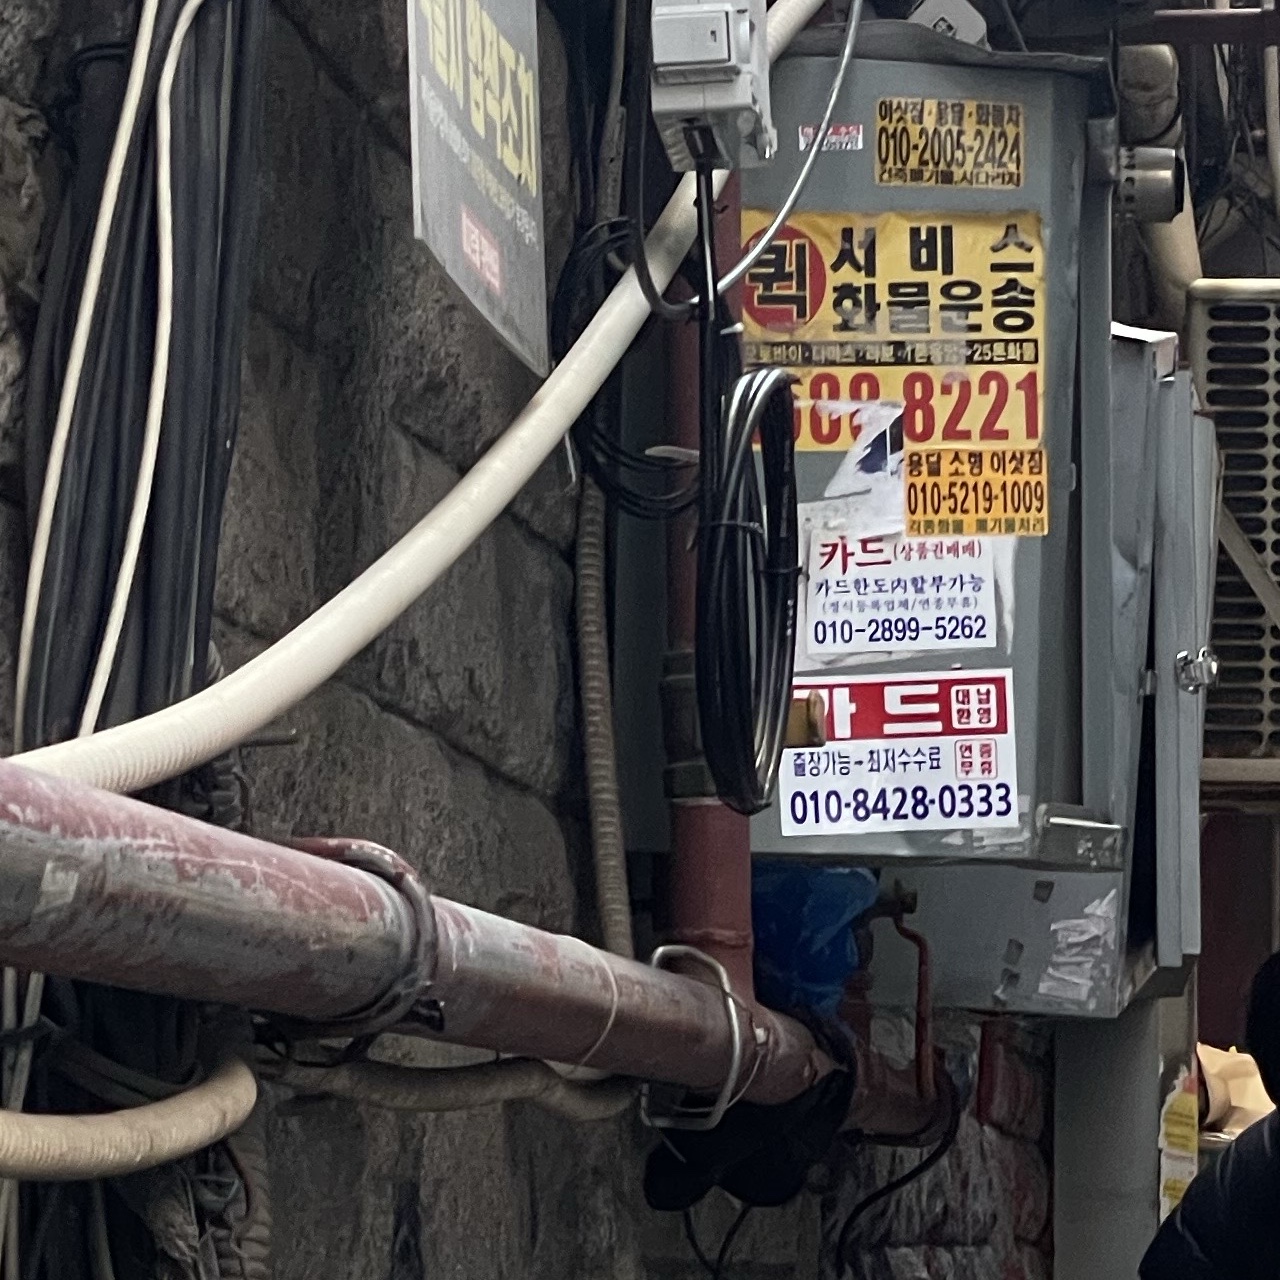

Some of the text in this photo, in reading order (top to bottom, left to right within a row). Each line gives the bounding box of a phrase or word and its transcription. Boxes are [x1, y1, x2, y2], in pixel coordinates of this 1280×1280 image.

[877, 127, 1022, 171] 010-2005-2424
[830, 224, 1034, 278] 서비스
[832, 277, 1035, 334] 화물운송
[908, 452, 941, 477] 용달
[990, 450, 1043, 476] 이삿짐
[908, 480, 1044, 515] 010-5219-1009
[819, 536, 892, 575] 카드
[813, 614, 987, 644] 010-2899-5262
[789, 782, 1012, 824] 010-8428-0333
